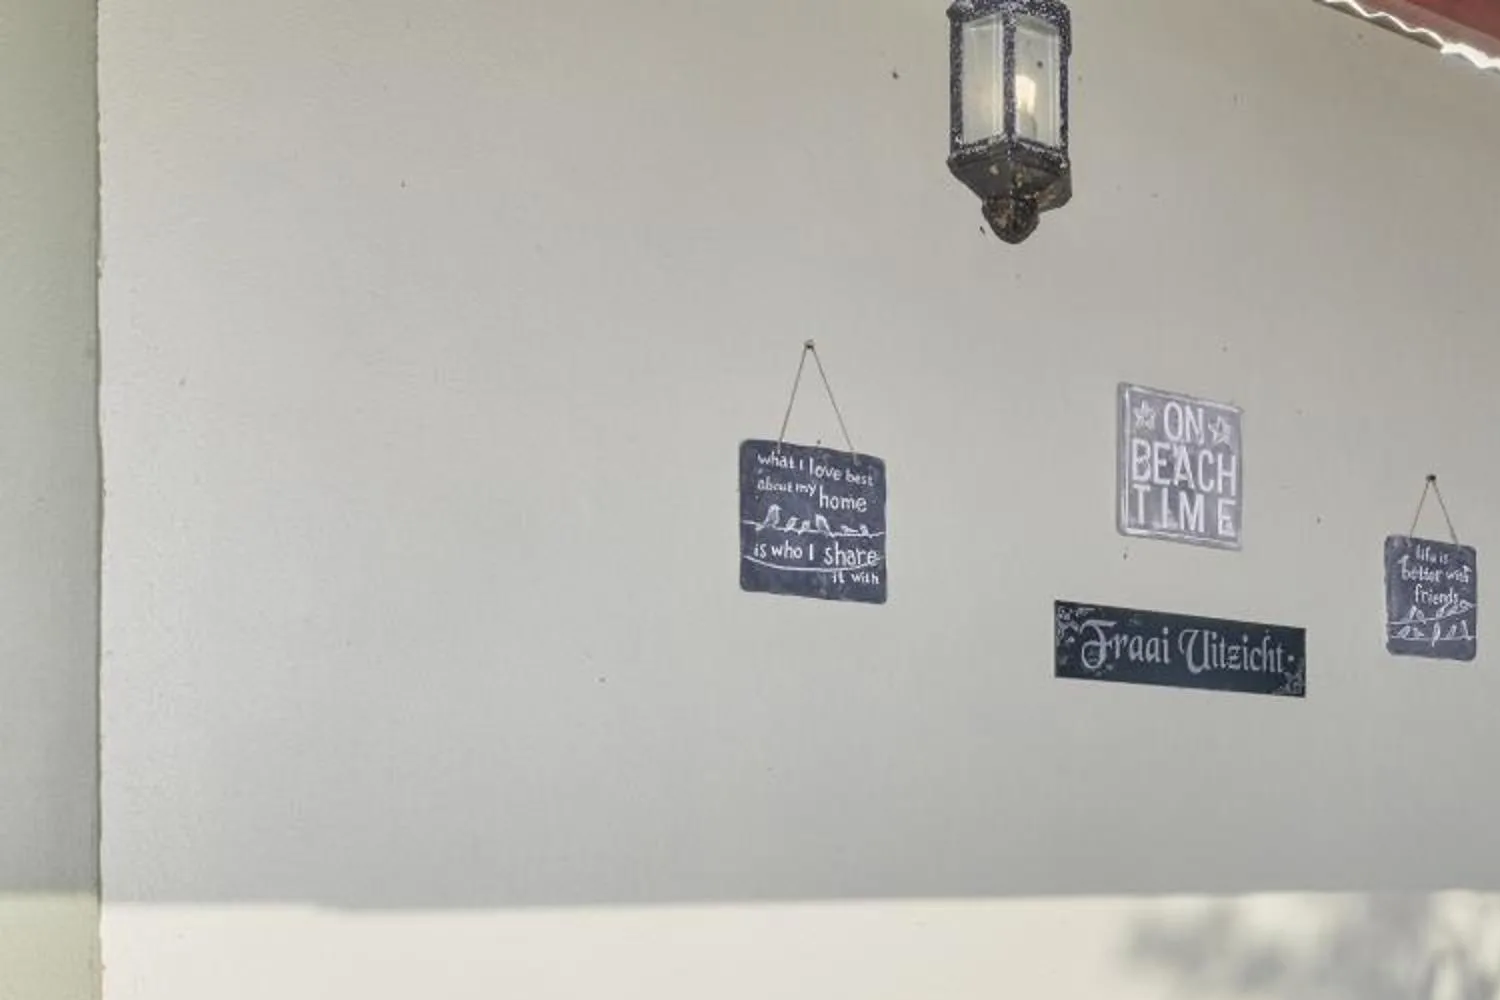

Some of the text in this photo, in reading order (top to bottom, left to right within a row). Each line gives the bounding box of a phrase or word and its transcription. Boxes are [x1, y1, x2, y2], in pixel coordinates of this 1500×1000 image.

[1163, 401, 1205, 446] ON
[757, 450, 795, 470] what
[808, 456, 843, 482] love
[845, 470, 875, 487] best
[1132, 437, 1237, 497] BEACH
[757, 475, 868, 513] about my home
[1132, 483, 1237, 537] TIME
[753, 543, 768, 559] is
[770, 540, 803, 560] who
[823, 541, 878, 567] share
[1397, 554, 1443, 583] better
[831, 571, 881, 585] it with
[1414, 582, 1459, 606] friends
[1079, 618, 1285, 674] Fraai Uitzicht
